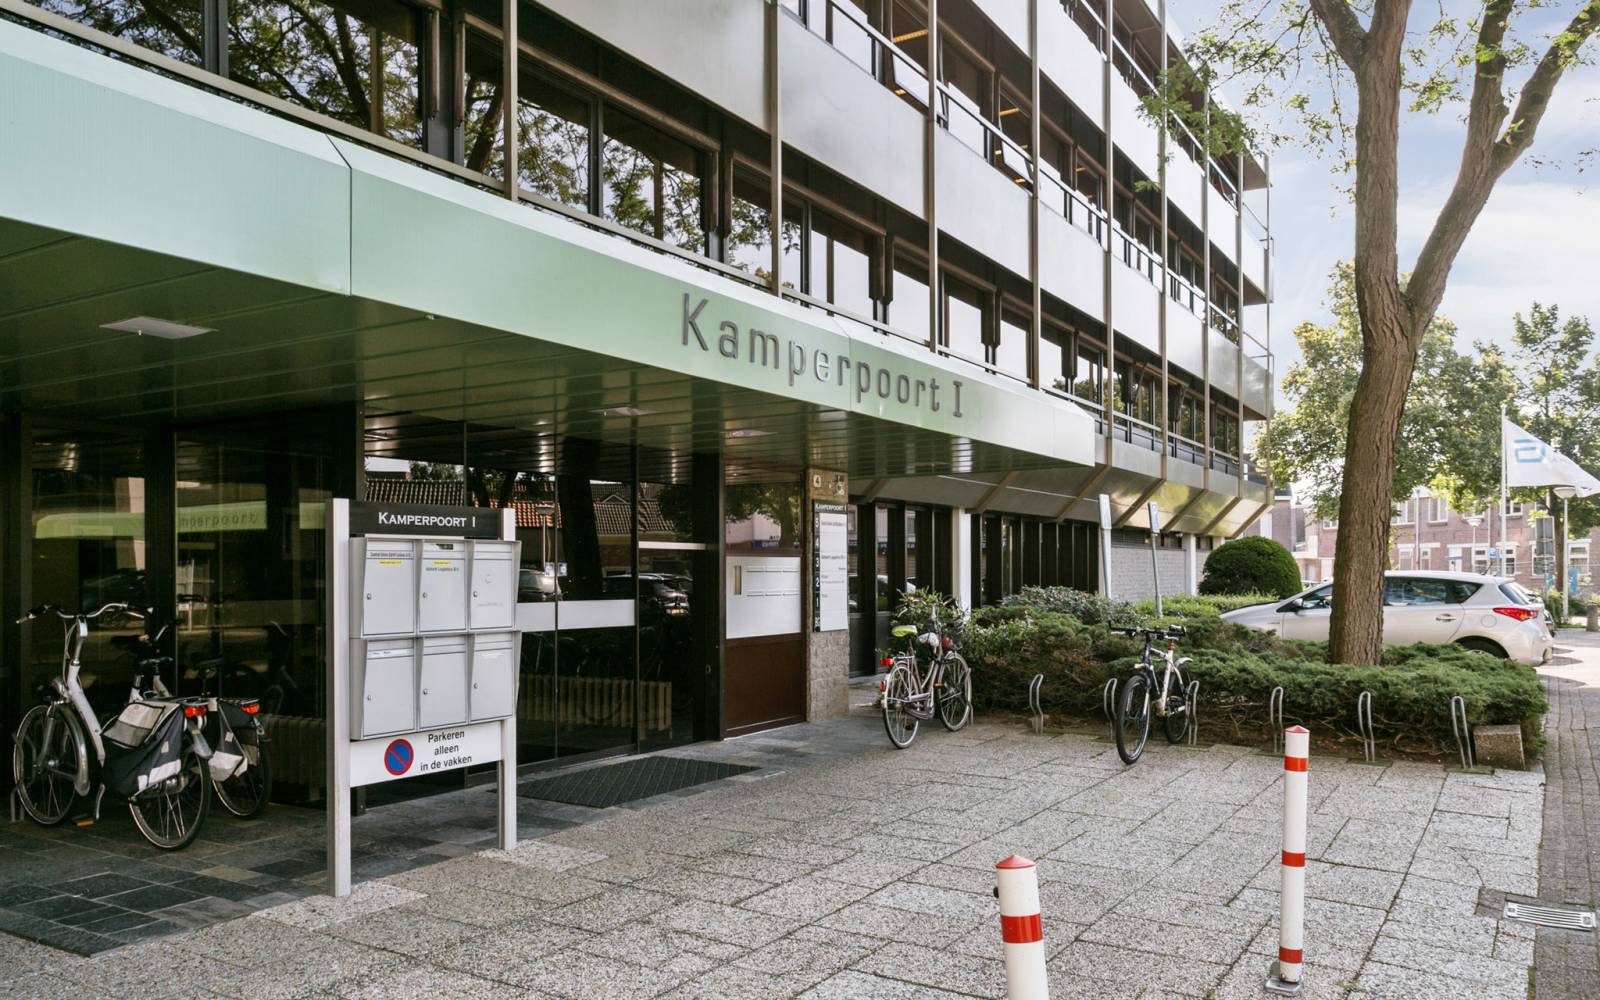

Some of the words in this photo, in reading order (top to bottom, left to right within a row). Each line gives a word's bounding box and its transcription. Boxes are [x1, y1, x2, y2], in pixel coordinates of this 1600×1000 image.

[682, 292, 940, 412] Kamperpoort
[952, 380, 962, 417] I
[378, 512, 467, 527] KAMPERPOORT
[472, 516, 476, 528] I
[815, 576, 820, 588] 2
[428, 731, 465, 743] Parkeren
[434, 744, 459, 756] alleen
[420, 762, 428, 771] in
[430, 759, 441, 769] de
[443, 755, 472, 767] vakken
